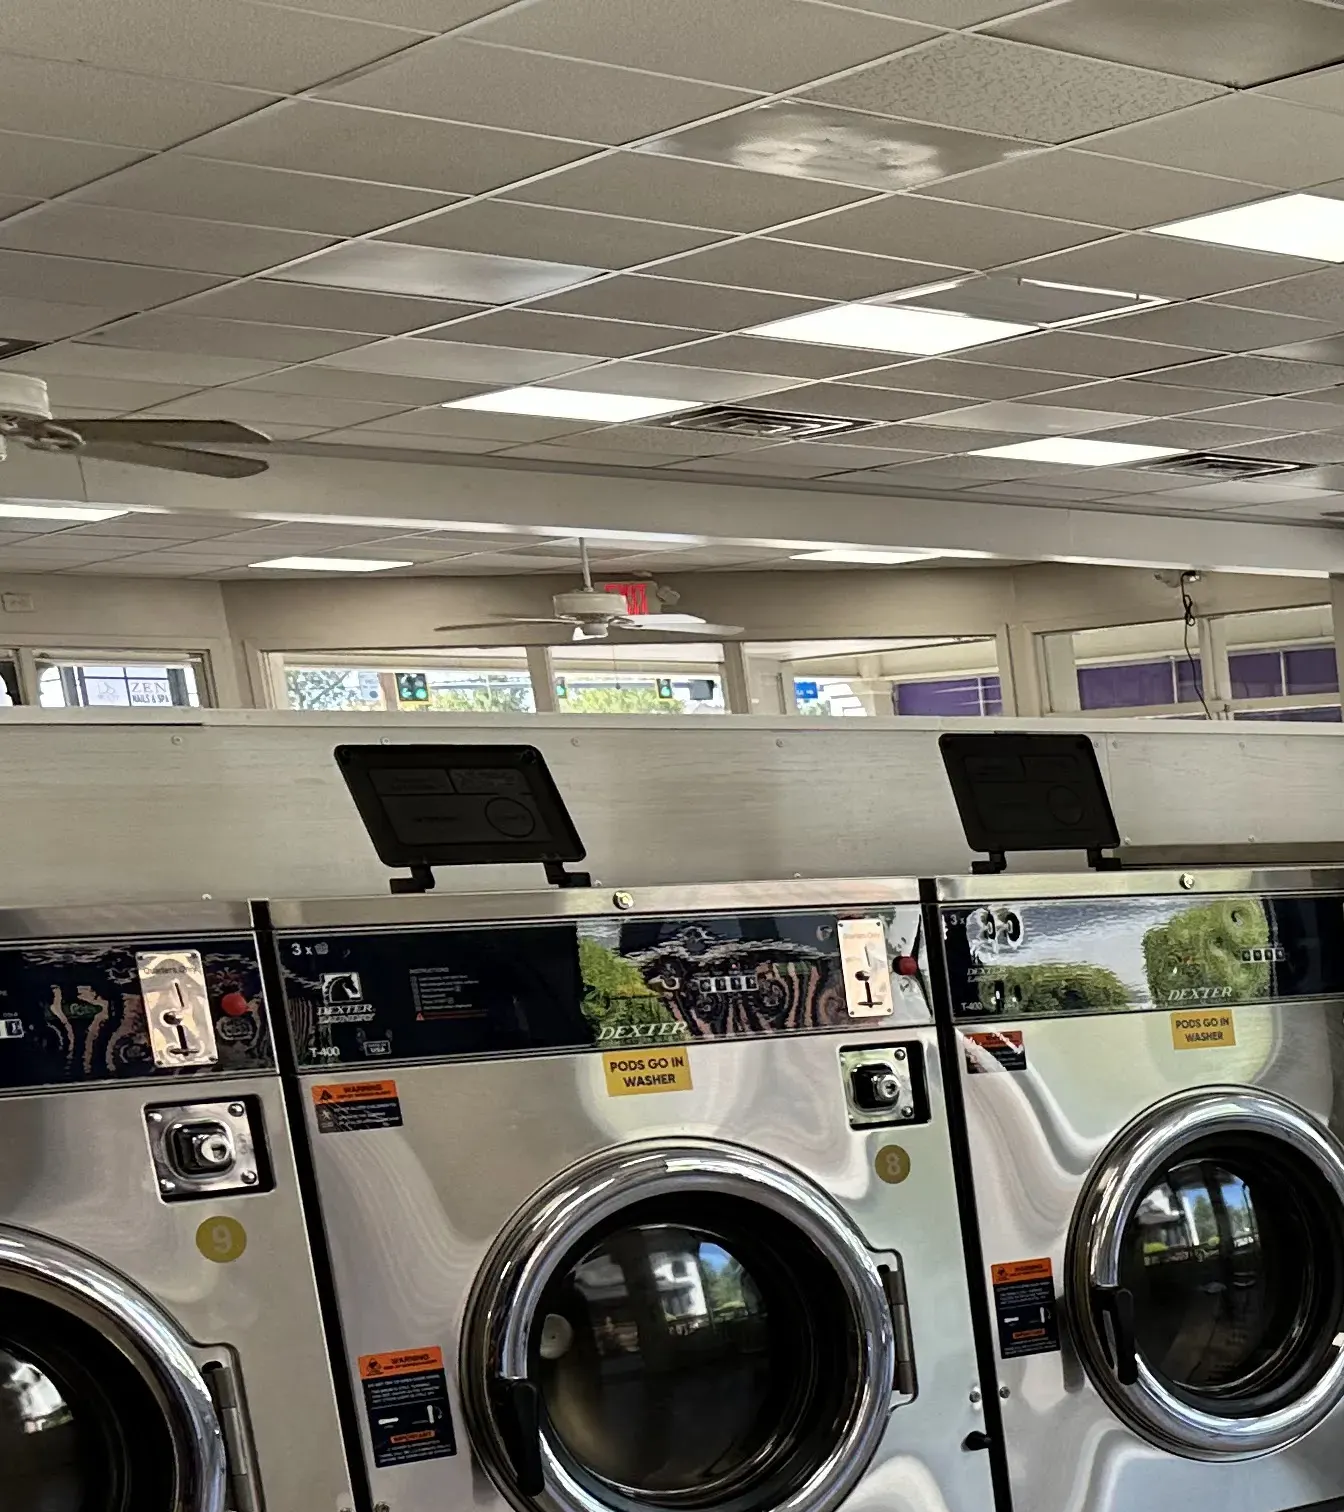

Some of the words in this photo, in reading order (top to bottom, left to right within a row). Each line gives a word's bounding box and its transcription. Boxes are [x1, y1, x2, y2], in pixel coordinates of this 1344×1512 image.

[130, 682, 167, 693] ZEN
[132, 694, 150, 703] NAILS
[158, 694, 170, 703] SPA
[950, 914, 957, 926] 3
[291, 943, 302, 956] 3
[305, 946, 313, 956] x
[1168, 986, 1232, 1001] DEXTER
[317, 1004, 373, 1016] DEXTER
[1175, 1019, 1201, 1029] PODS
[1203, 1018, 1218, 1027] GO
[1220, 1017, 1230, 1026] IN
[597, 1021, 688, 1040] DEXTER
[1185, 1031, 1223, 1042] WASHER
[308, 1046, 340, 1057] T-400
[610, 1060, 645, 1073] PODS
[648, 1058, 668, 1069] GO
[671, 1056, 684, 1068] IN
[623, 1073, 676, 1087] WASHER
[886, 1153, 901, 1176] 8
[212, 1224, 232, 1254] 9
